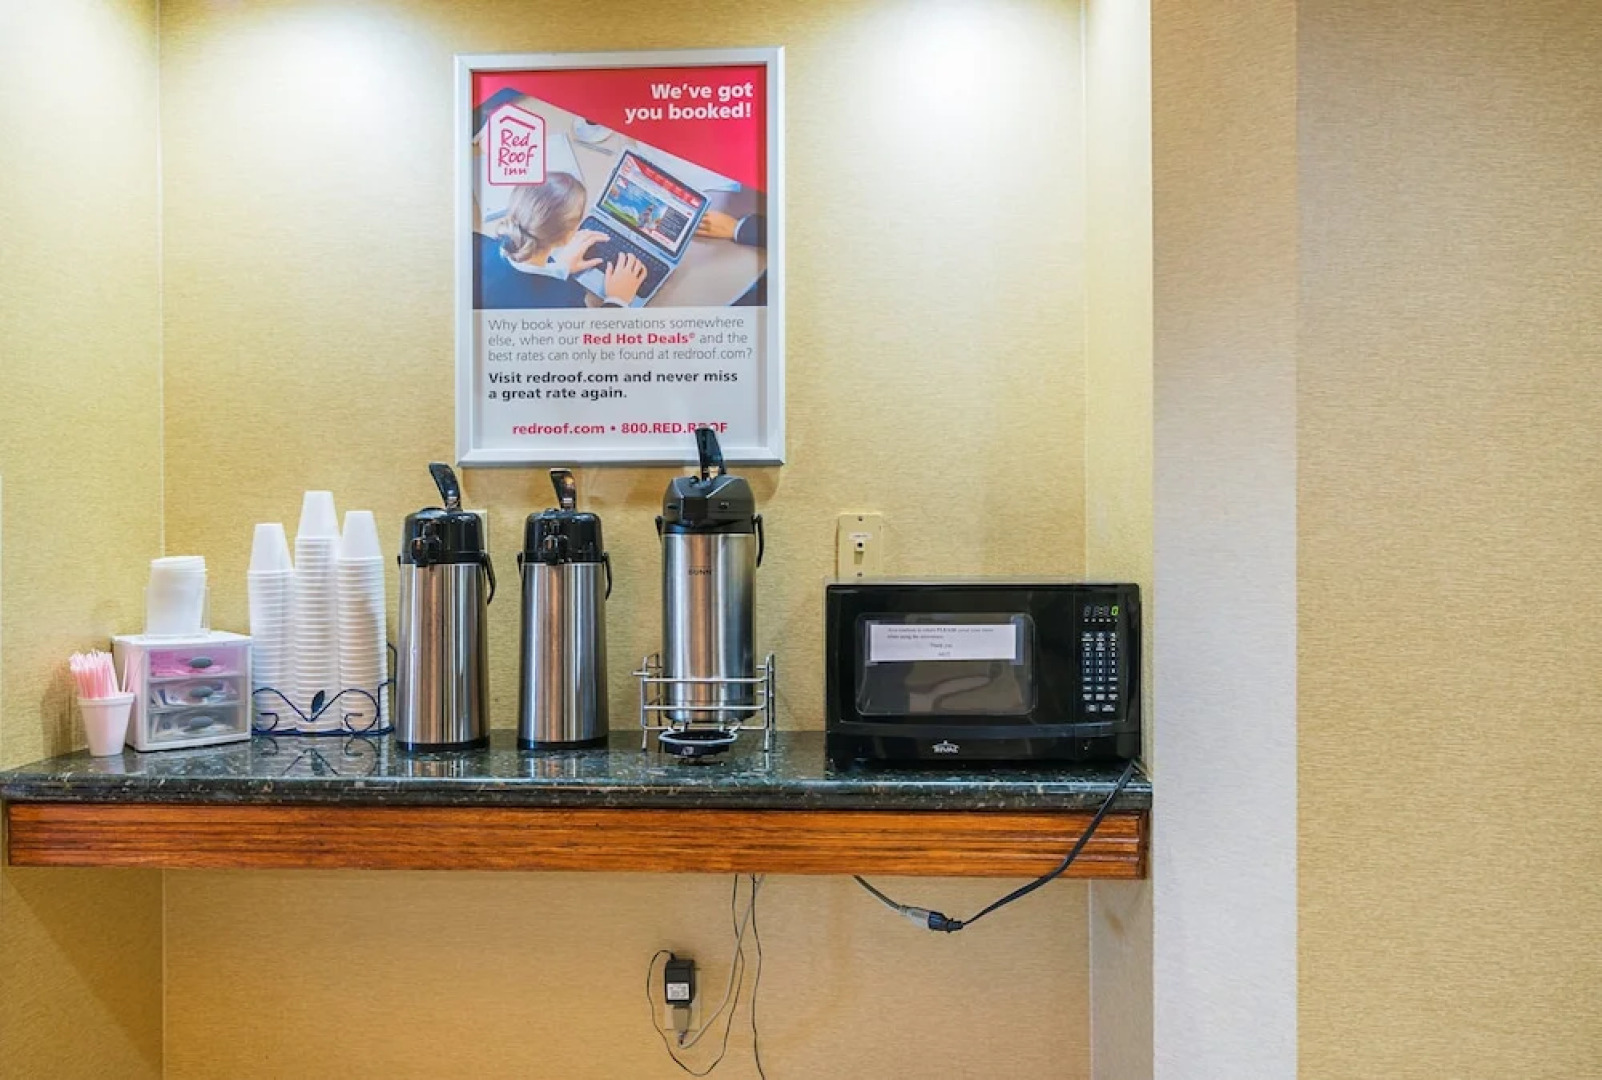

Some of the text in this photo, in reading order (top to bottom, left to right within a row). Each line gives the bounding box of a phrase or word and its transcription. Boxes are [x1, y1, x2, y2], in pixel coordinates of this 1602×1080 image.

[651, 82, 754, 104] We've got
[624, 101, 752, 124] you booked!
[500, 128, 531, 147] Red
[498, 144, 538, 167] Roof
[488, 316, 745, 333] Why book your reservations somewhere
[488, 334, 515, 347] else,
[520, 333, 554, 346] when
[558, 336, 580, 346] our
[582, 333, 612, 345] Red
[615, 333, 643, 345] Hot
[699, 332, 723, 344] and
[728, 332, 748, 344] the
[488, 346, 753, 364] best rates can only be found at redroof.com?
[488, 369, 738, 384] Visit redroof.com and never miss
[488, 386, 628, 403] a great rate again.
[512, 422, 605, 435] redroof.com
